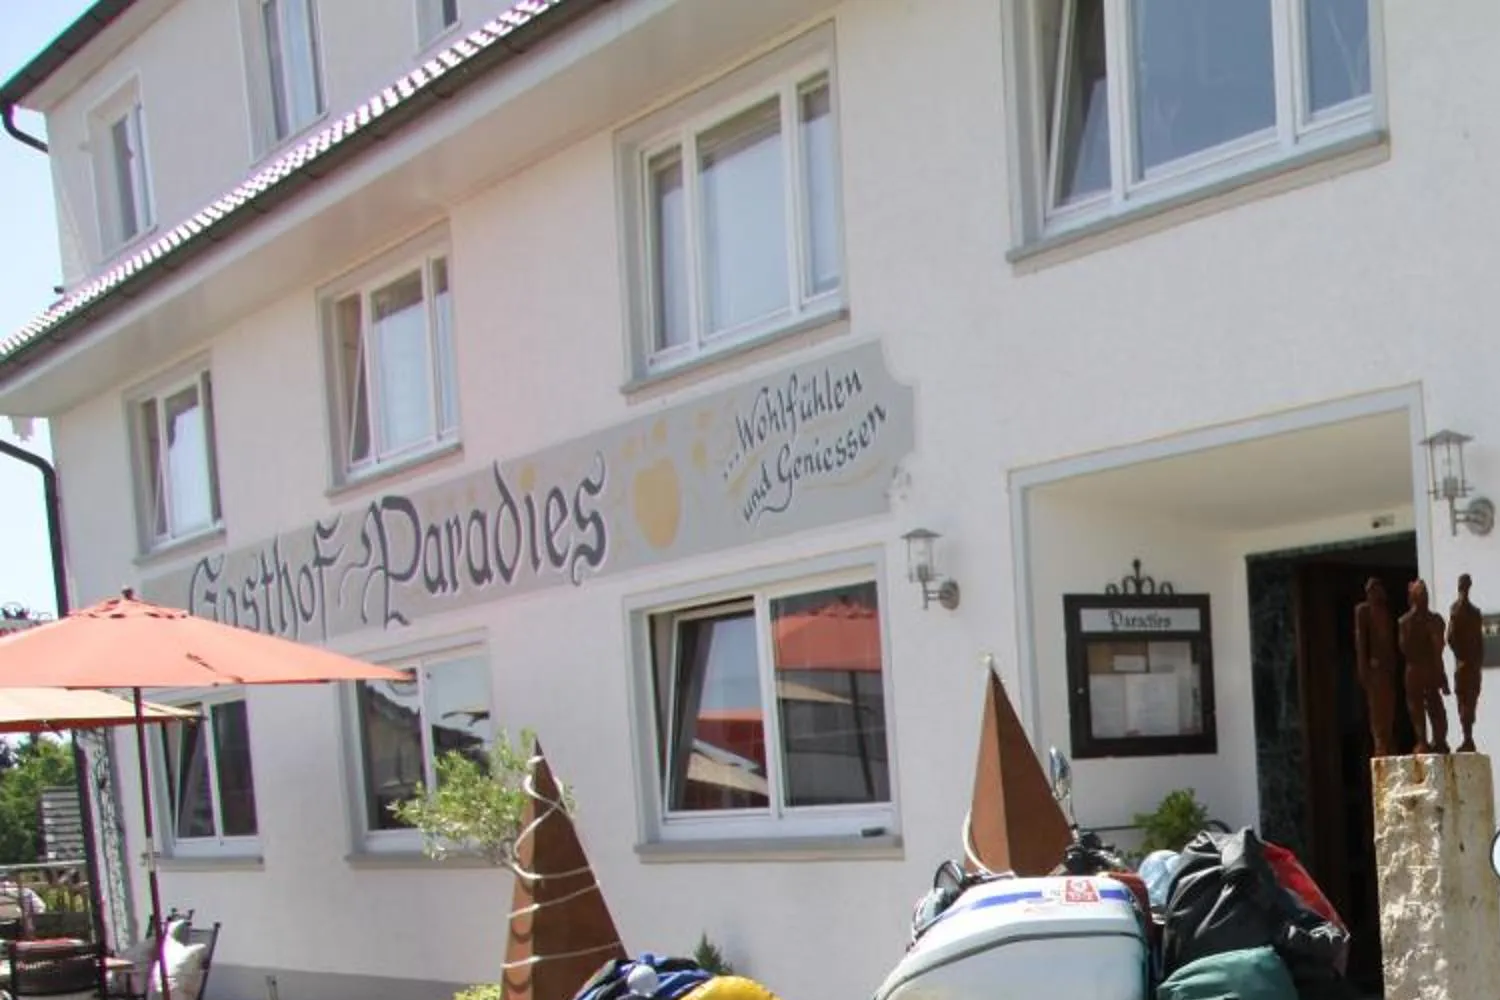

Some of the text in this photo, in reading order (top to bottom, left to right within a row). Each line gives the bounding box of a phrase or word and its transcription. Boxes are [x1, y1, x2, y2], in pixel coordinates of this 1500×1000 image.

[189, 450, 608, 643] Gasthof Paradies
[743, 461, 772, 522] und
